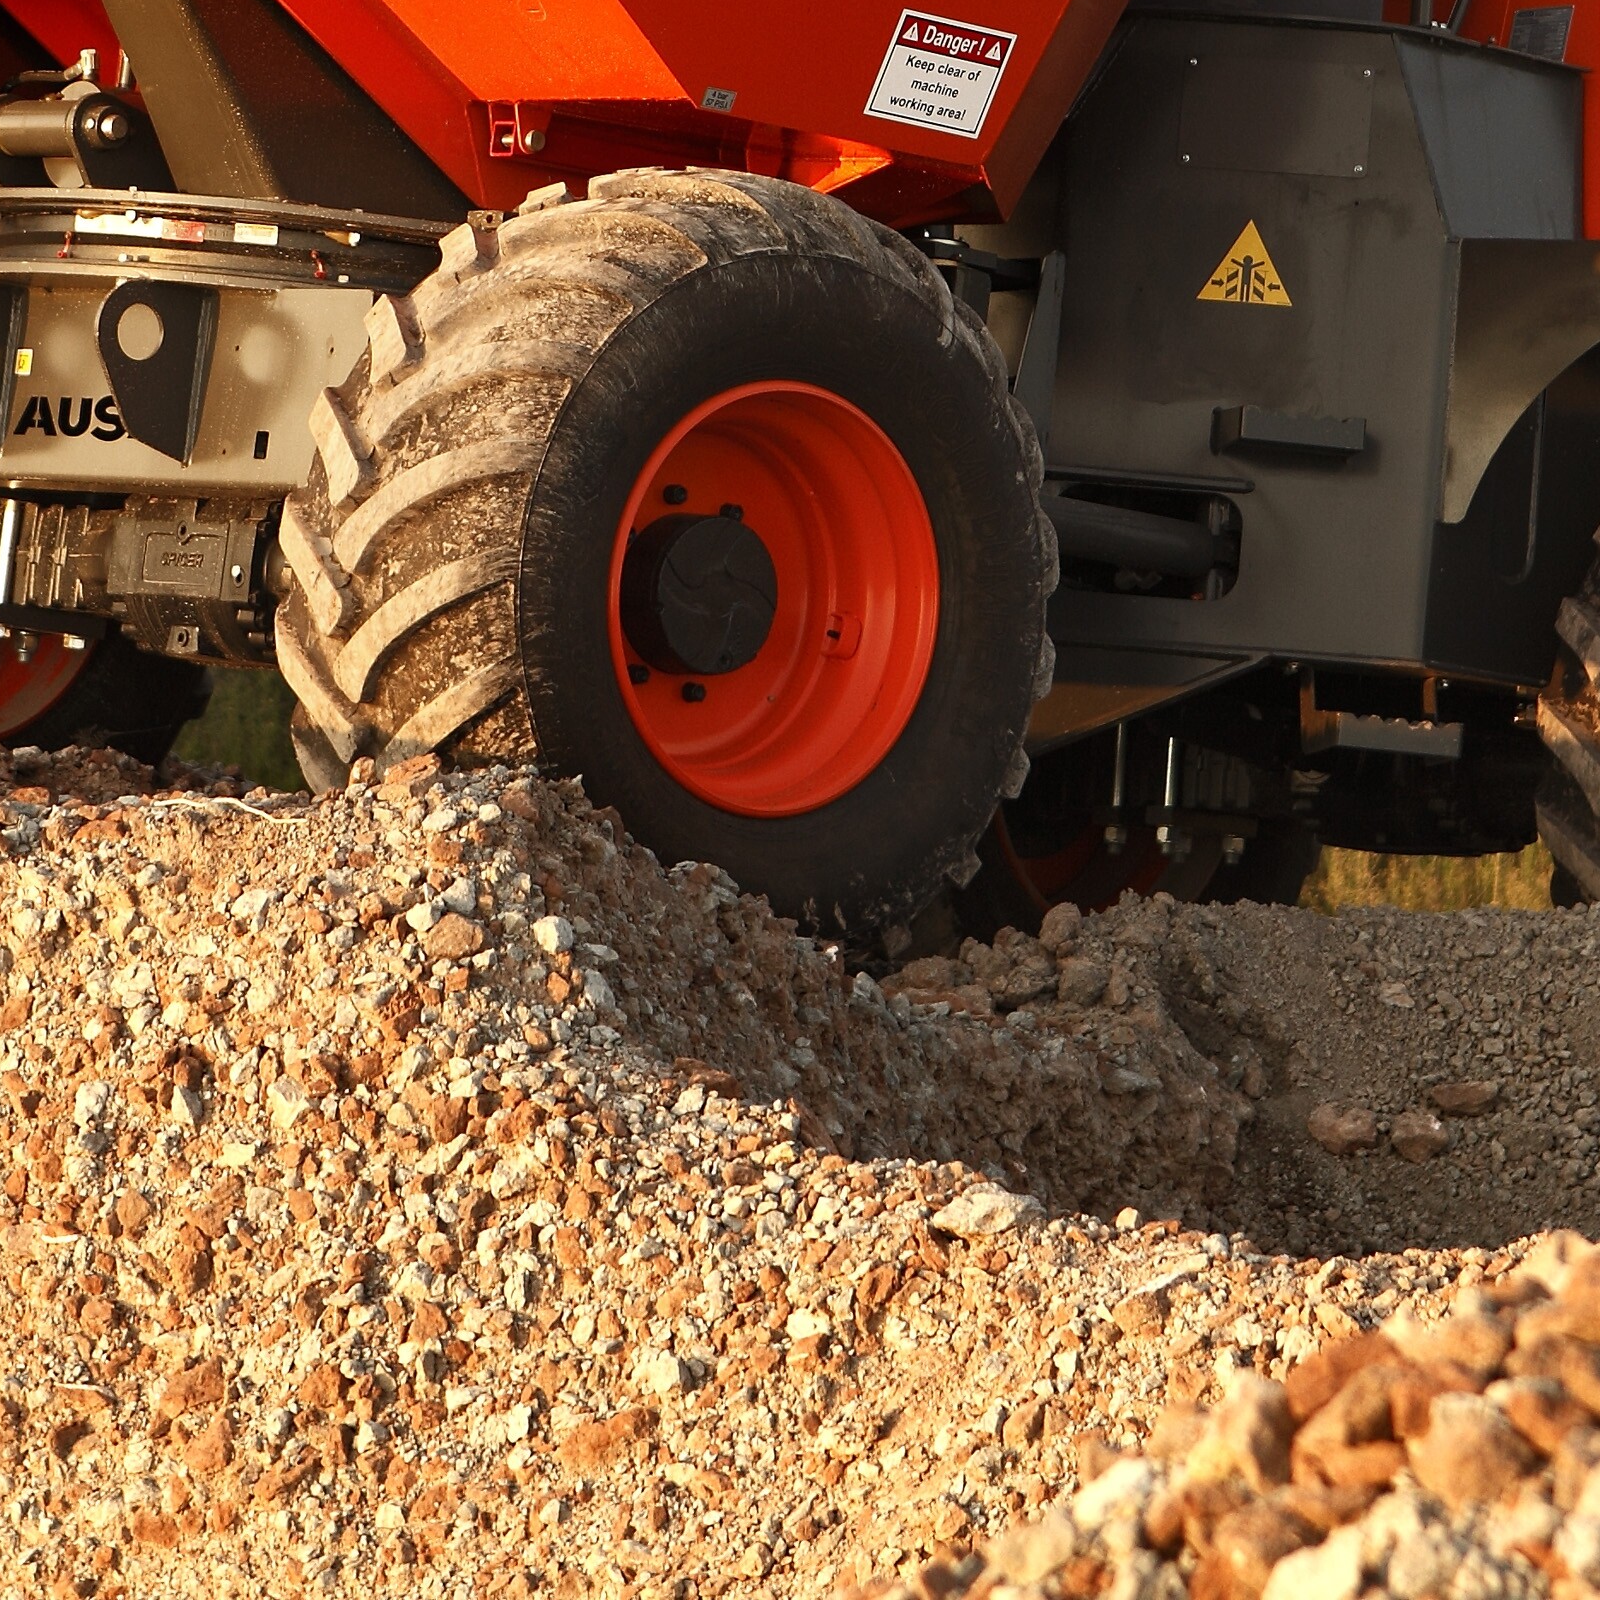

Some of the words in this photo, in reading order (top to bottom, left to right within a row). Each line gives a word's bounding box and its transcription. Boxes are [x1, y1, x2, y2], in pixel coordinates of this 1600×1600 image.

[906, 54, 935, 72] Keep
[938, 64, 966, 78] clear
[968, 71, 981, 82] of
[911, 80, 959, 98] machine
[890, 96, 935, 116] working
[937, 105, 966, 120] area!
[13, 394, 133, 442] AUS
